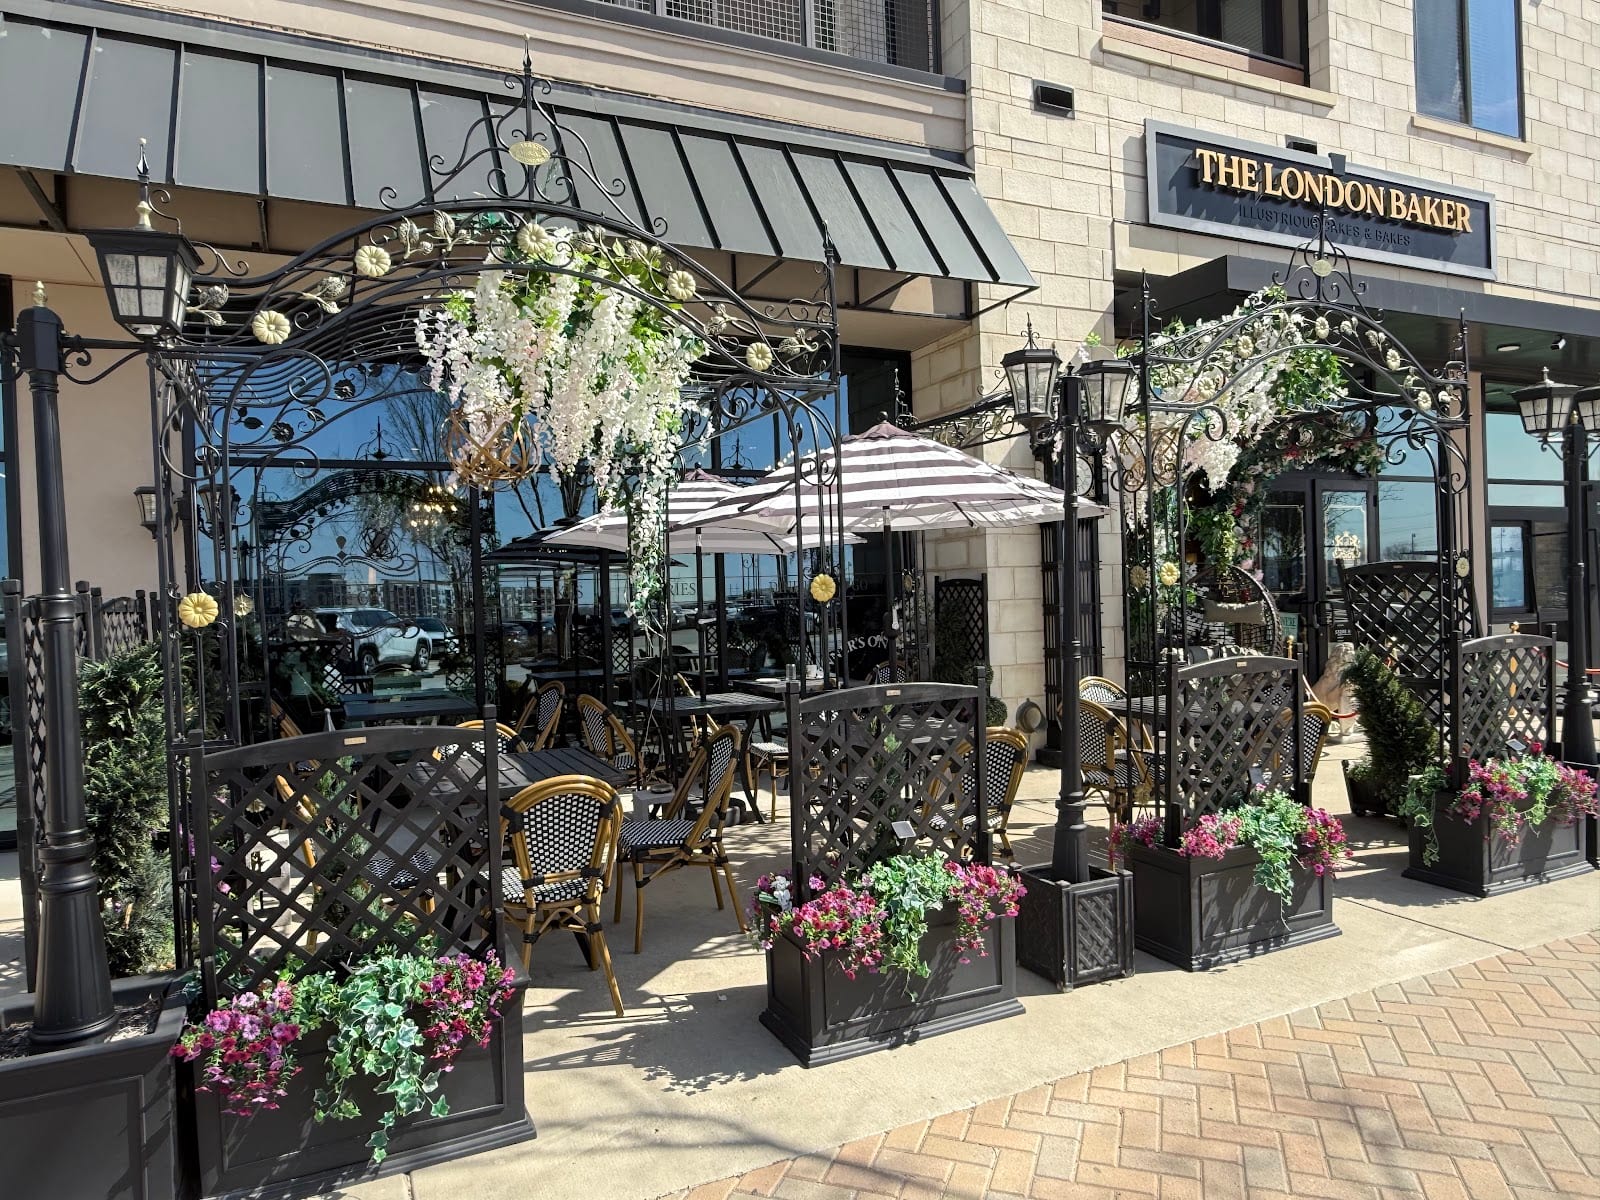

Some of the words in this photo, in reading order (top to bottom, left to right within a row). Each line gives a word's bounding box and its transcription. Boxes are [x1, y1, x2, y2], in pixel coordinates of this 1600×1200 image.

[1196, 148, 1258, 192] THE
[1264, 162, 1385, 216] LONDON
[1389, 188, 1473, 233] BAKER
[1364, 227, 1373, 240] &
[1375, 231, 1411, 246] BAKES
